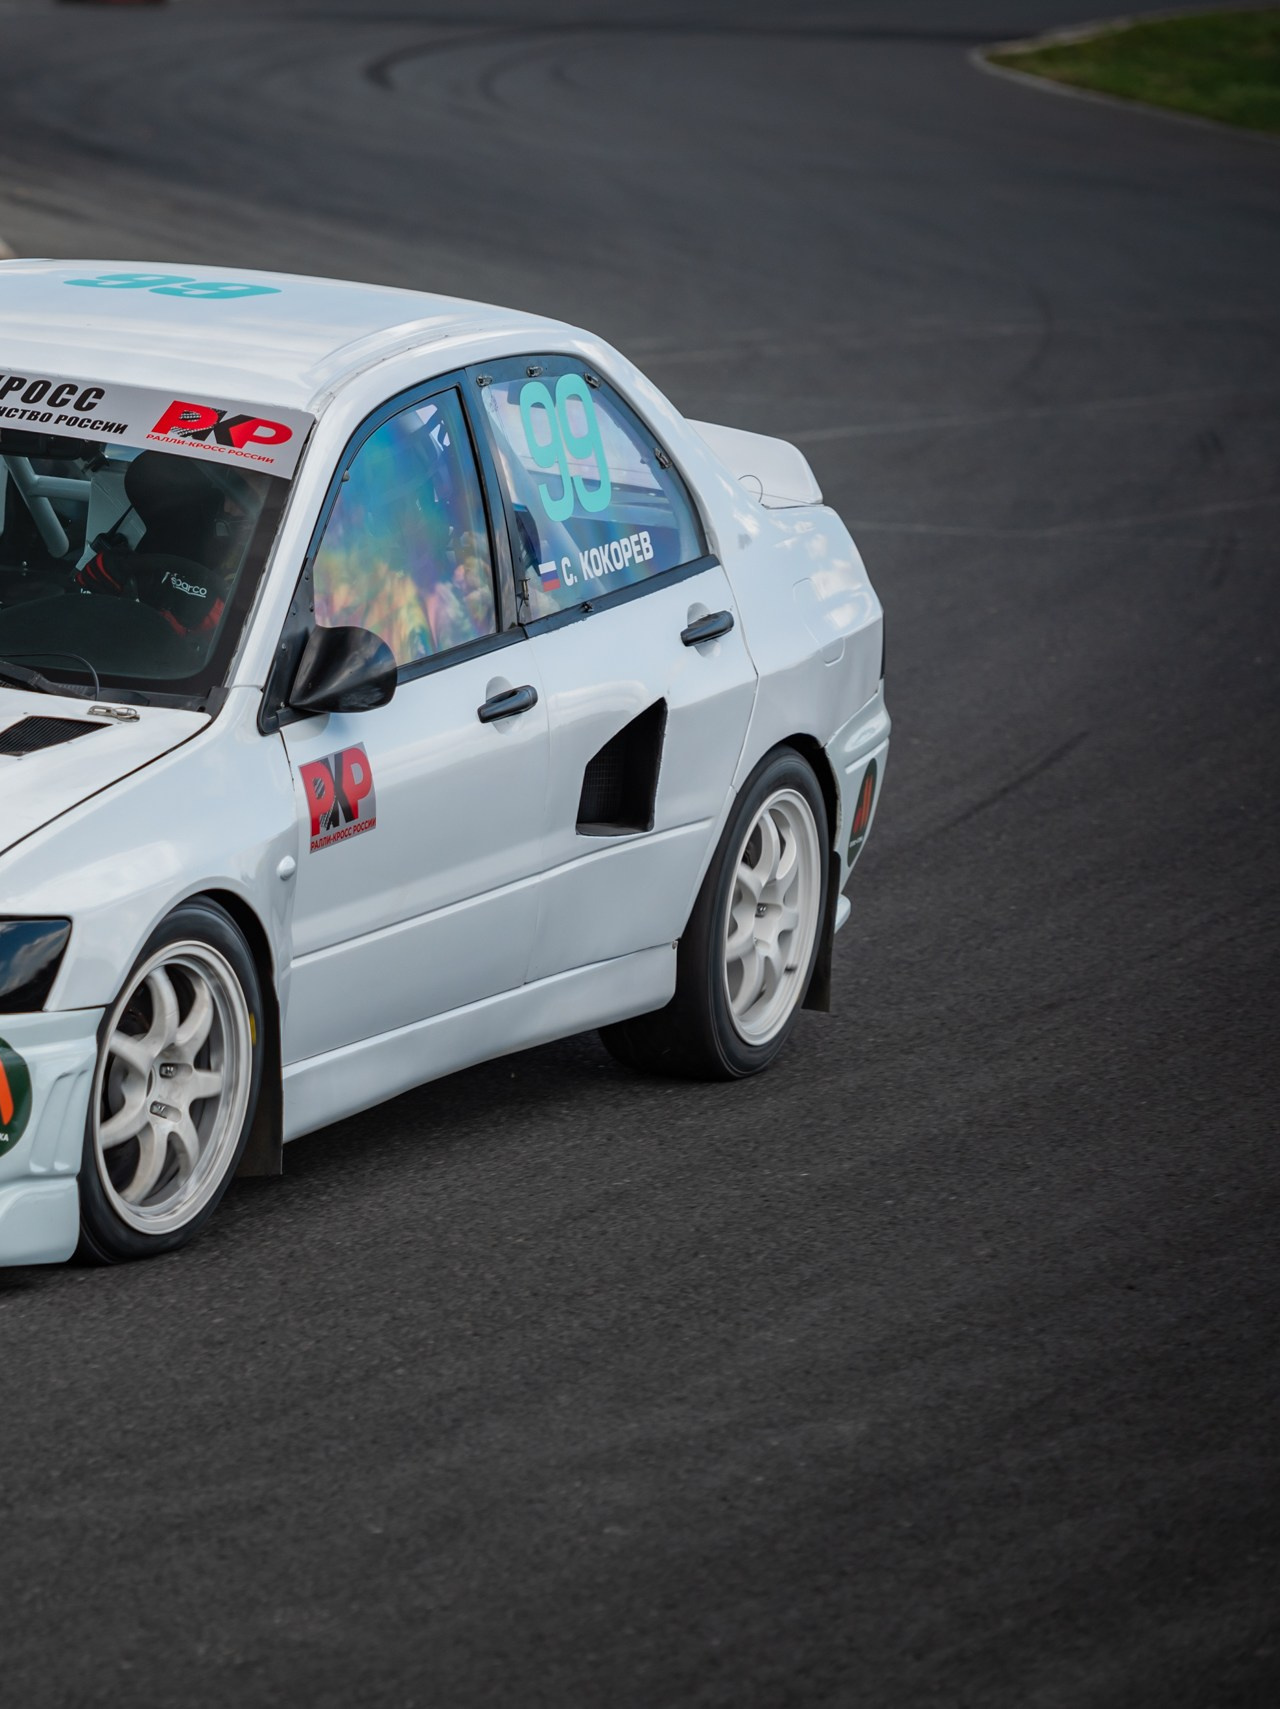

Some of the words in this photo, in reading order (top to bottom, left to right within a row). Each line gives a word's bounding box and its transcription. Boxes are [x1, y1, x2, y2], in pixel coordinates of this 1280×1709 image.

[63, 273, 282, 299] 99
[54, 415, 128, 434] РОССИИ
[146, 434, 227, 454] РАЛЛИ-КРОСС
[228, 449, 275, 464] РОССИИ
[520, 373, 612, 522] 99
[561, 556, 578, 587] С.
[580, 530, 654, 580] КОКОРЕВ
[171, 576, 208, 596] sparco
[311, 826, 353, 851] РАЛЛИ-КРОСС
[353, 817, 377, 833] РОССИИ
